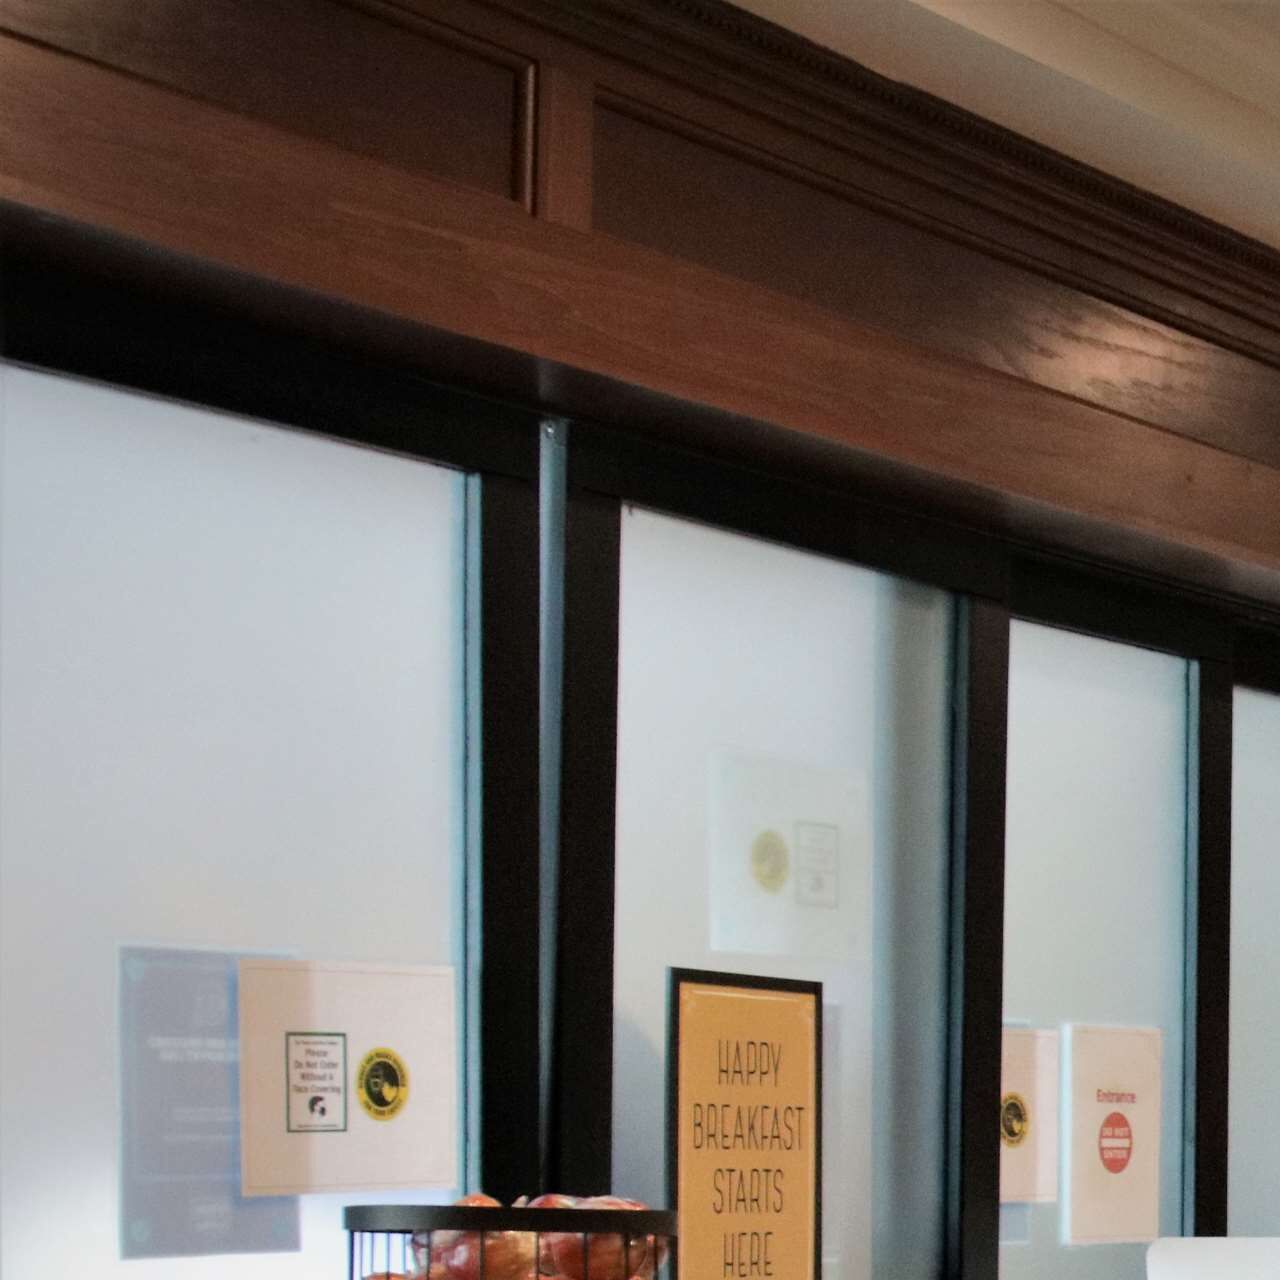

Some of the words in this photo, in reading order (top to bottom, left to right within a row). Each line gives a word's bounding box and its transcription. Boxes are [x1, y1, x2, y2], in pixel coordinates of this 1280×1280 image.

[717, 1039, 782, 1087] HAPPY
[693, 1104, 804, 1151] BREAKFAST
[713, 1168, 784, 1214] STARTS
[723, 1231, 774, 1278] HERE
